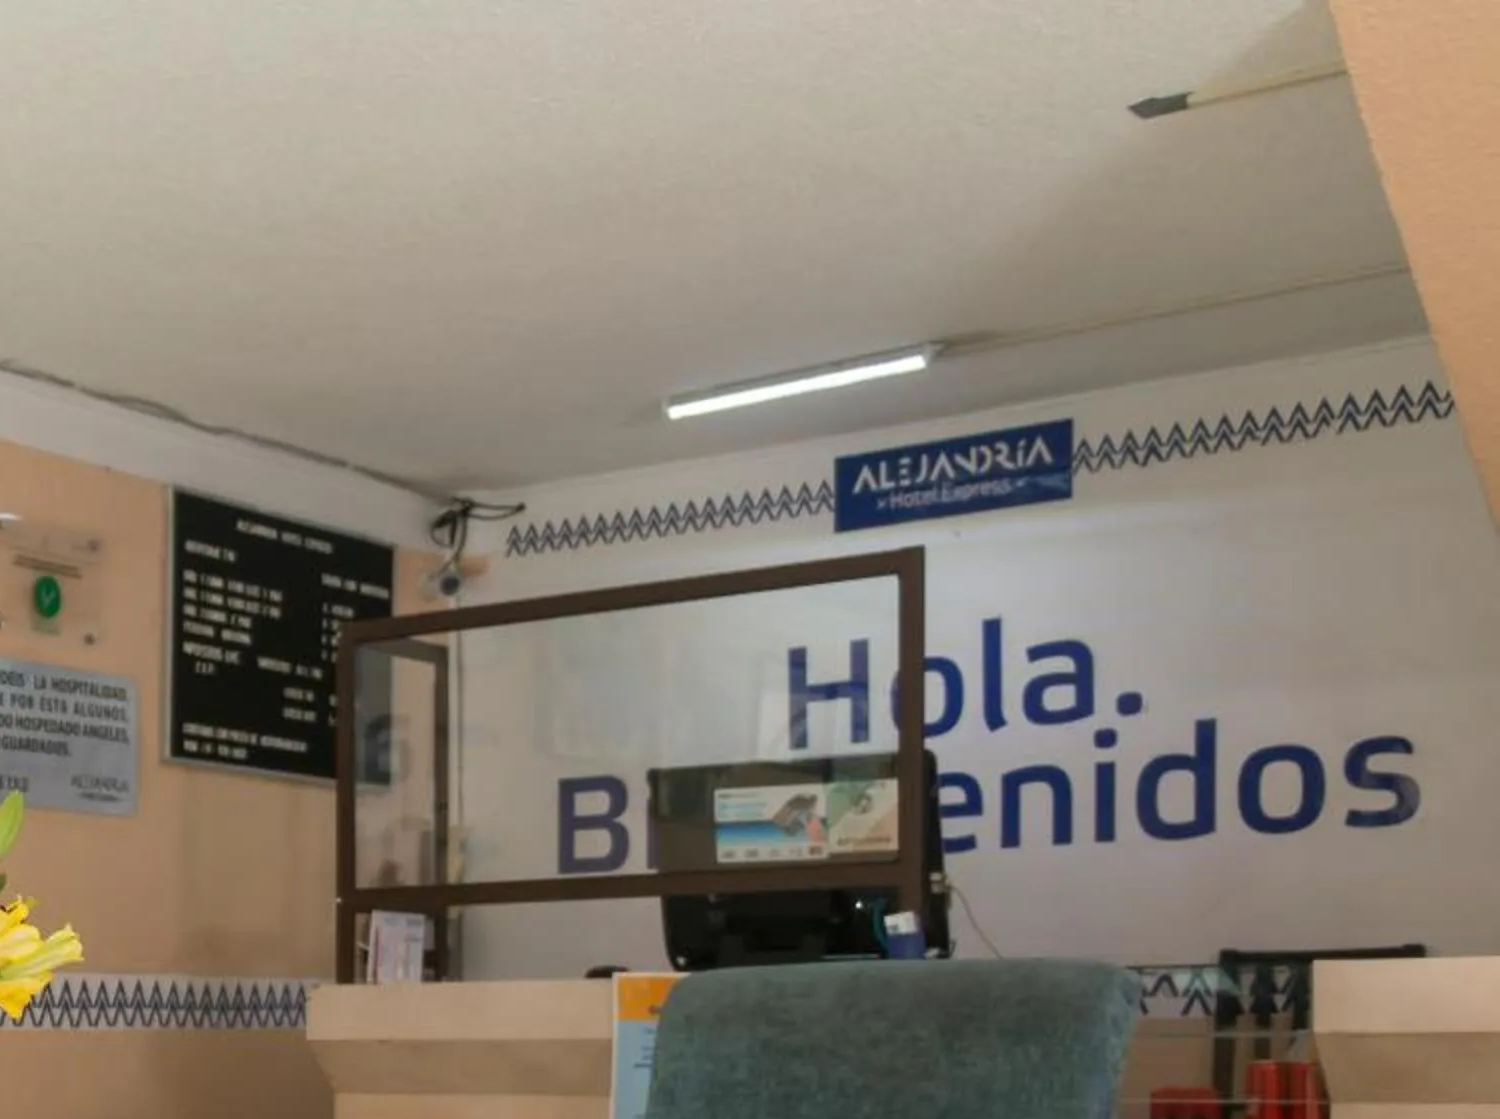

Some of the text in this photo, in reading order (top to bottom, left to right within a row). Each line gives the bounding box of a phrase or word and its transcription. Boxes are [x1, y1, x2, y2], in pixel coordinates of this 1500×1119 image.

[890, 478, 1012, 509] Hotel Express
[33, 674, 46, 690] LA
[788, 616, 1143, 750] Hola.
[10, 692, 33, 710] POR
[16, 715, 80, 737] HOSPEDADO
